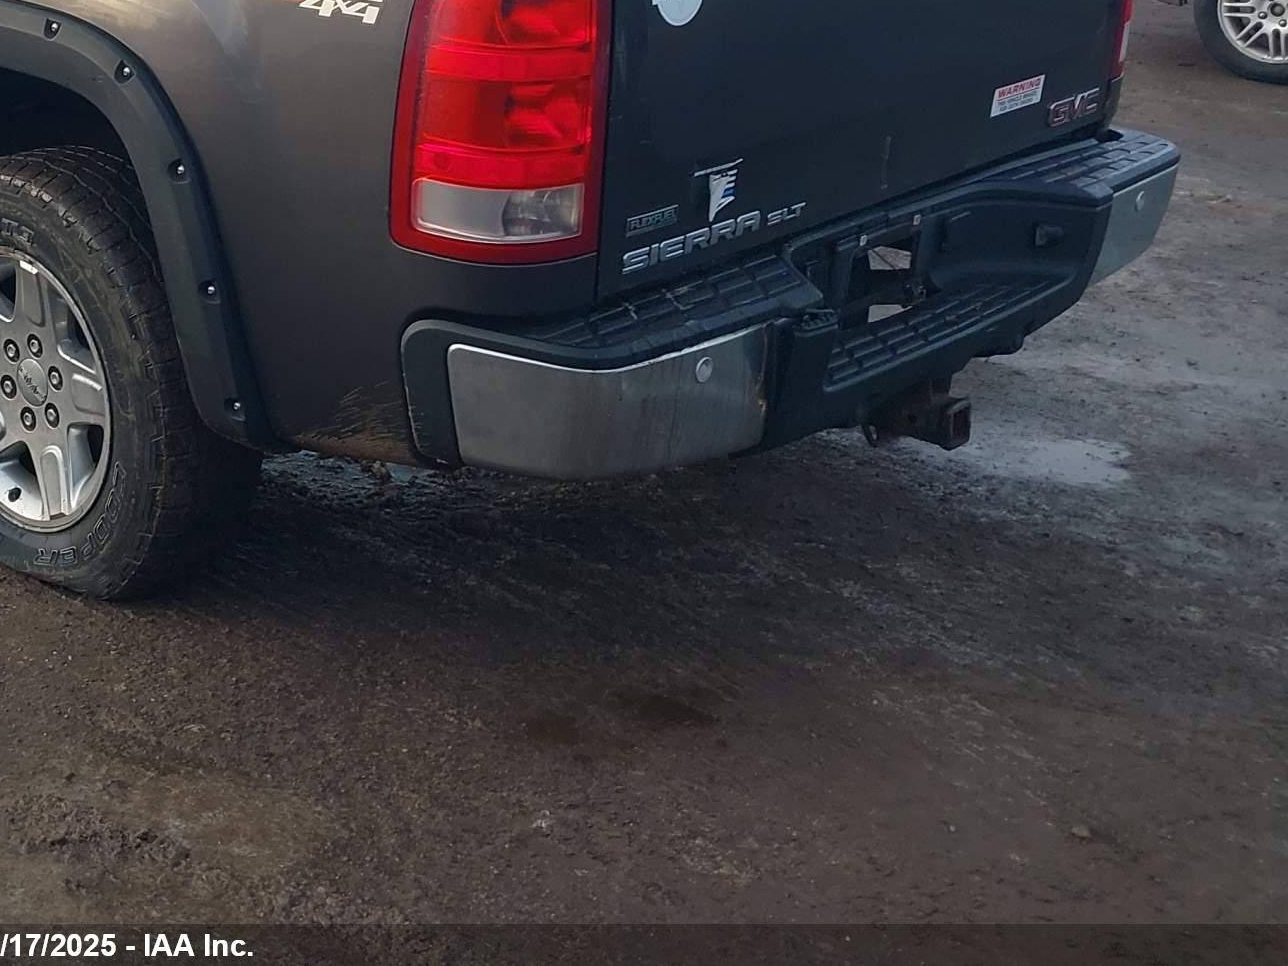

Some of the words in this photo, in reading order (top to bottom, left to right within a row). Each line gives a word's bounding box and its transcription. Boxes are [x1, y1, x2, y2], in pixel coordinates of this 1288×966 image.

[998, 77, 1041, 99] WARNING
[622, 210, 761, 275] SIERRA
[767, 202, 806, 226] SLT
[32, 460, 127, 567] COOPER
